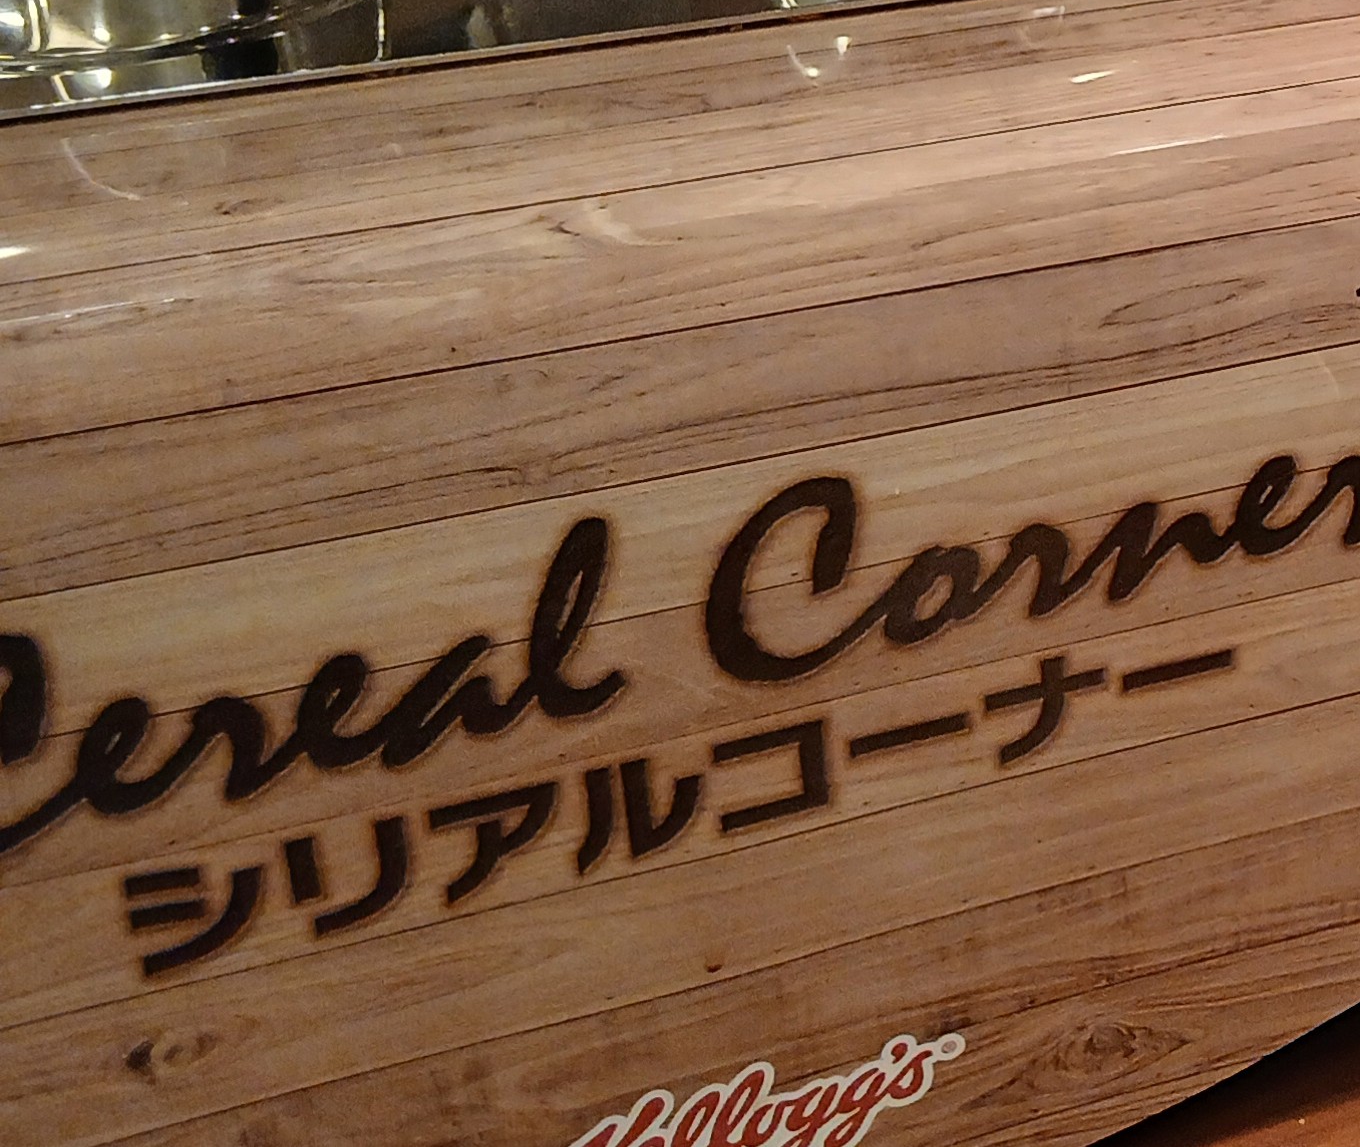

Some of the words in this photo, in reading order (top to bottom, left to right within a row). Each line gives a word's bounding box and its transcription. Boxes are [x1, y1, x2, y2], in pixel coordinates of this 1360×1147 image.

[124, 649, 1236, 979] シリアルコーナー
[580, 1042, 933, 1147] llogg's
